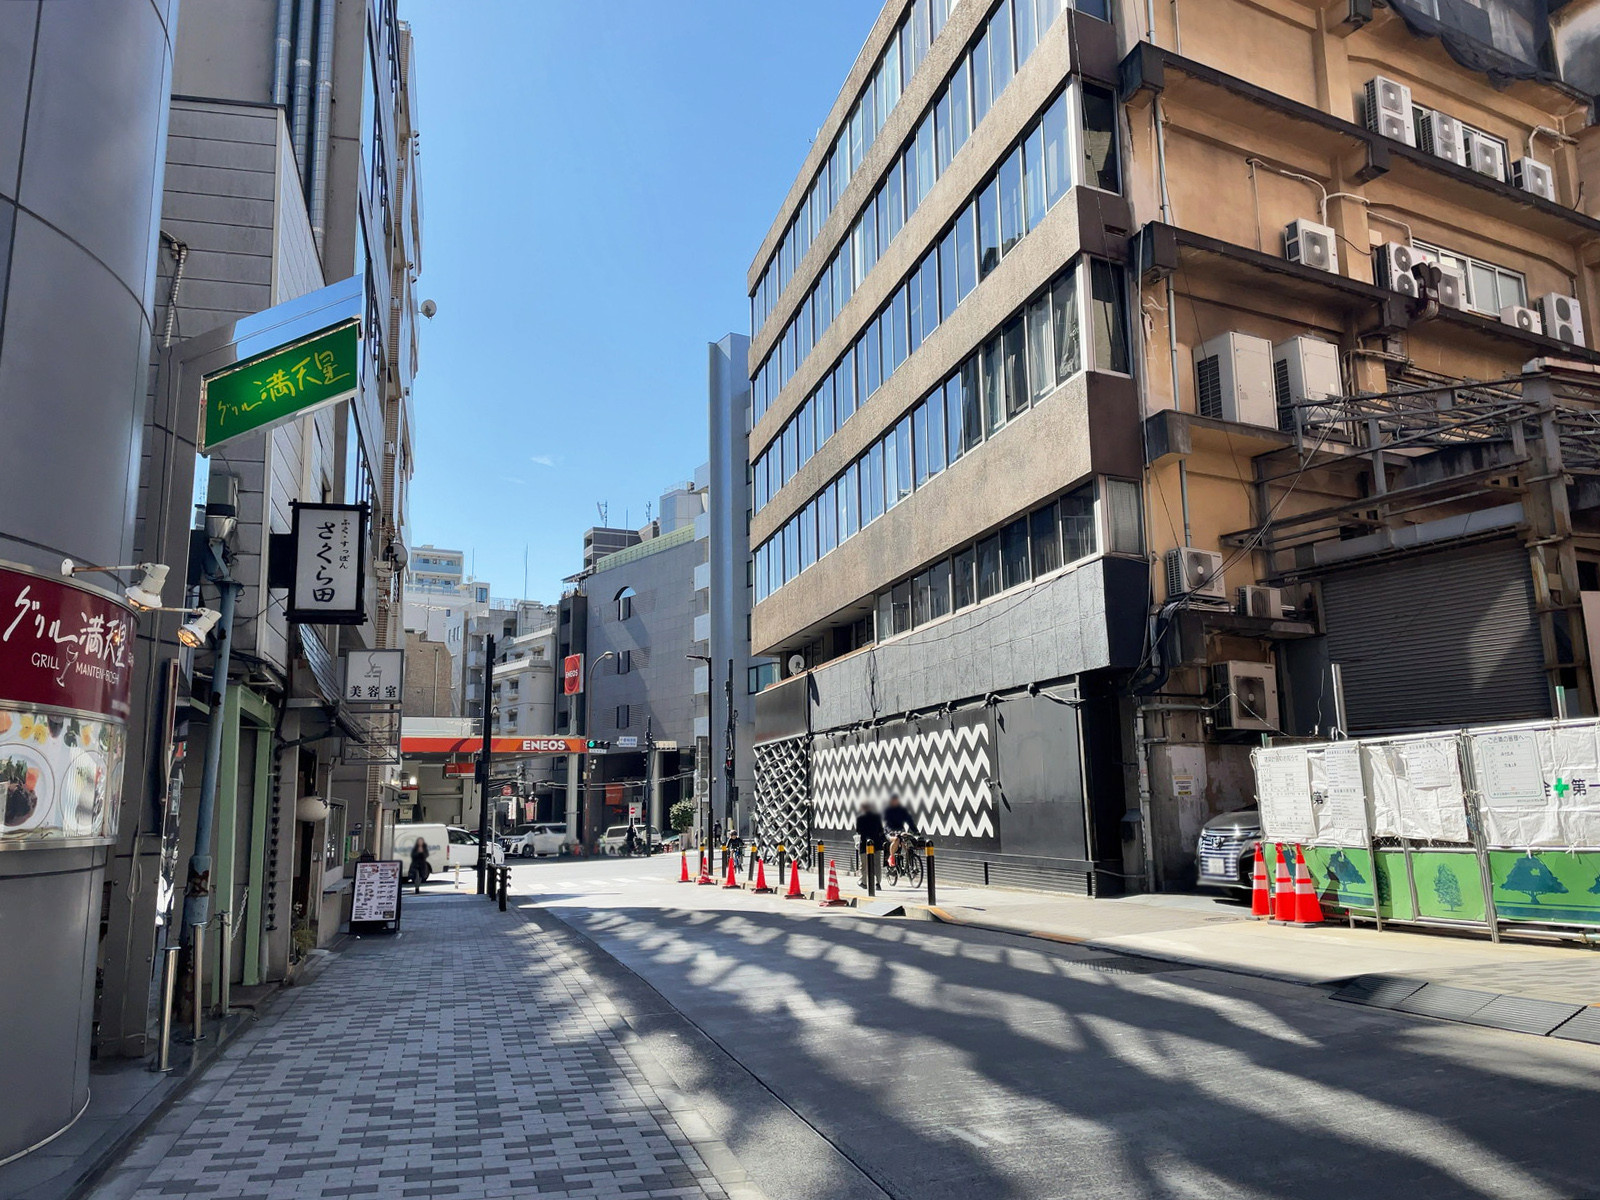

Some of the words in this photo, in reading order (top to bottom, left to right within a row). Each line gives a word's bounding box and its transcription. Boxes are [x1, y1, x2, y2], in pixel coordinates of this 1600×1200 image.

[217, 350, 350, 426] グリル満天星
[312, 521, 336, 603] さくら田
[2, 584, 125, 667] グリル満天星
[31, 652, 60, 670] GRILL
[565, 669, 578, 679] ENEOS
[349, 685, 397, 698] 美容室
[522, 740, 566, 751] ENEOS
